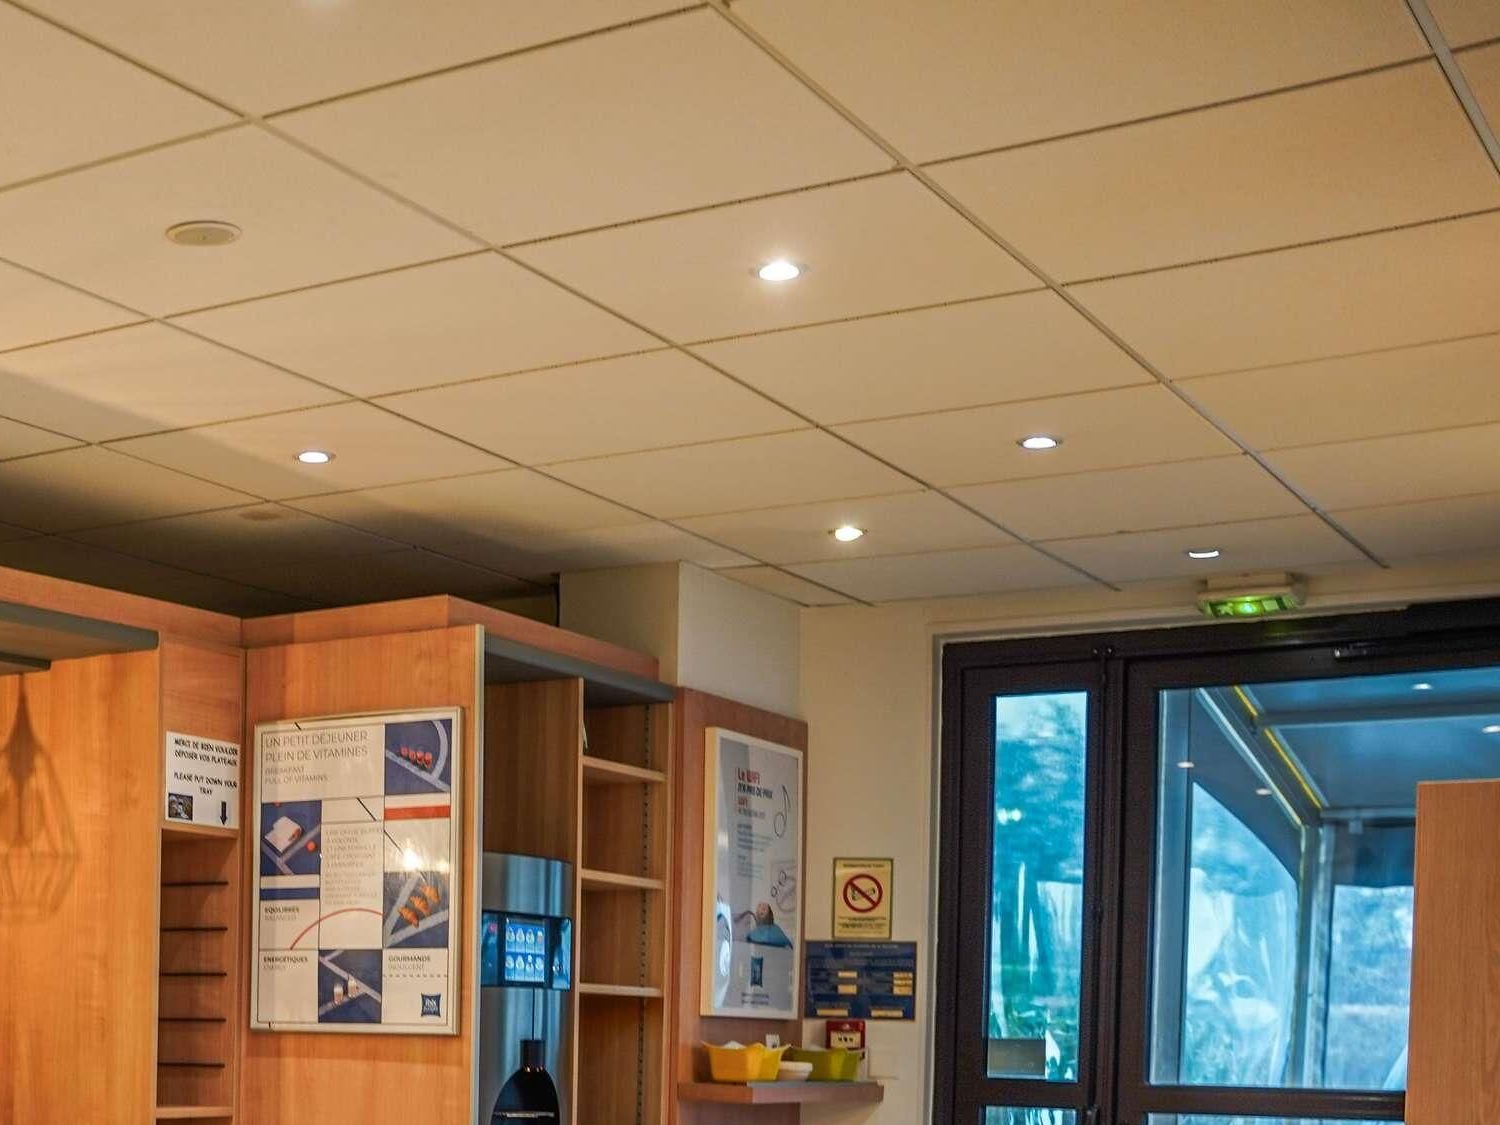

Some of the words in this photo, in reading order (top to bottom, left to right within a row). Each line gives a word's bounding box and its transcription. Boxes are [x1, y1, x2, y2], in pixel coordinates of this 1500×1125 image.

[283, 734, 310, 747] PETIT
[265, 750, 295, 762] PLEIN
[296, 750, 311, 761] DE
[311, 747, 368, 761] VITAMINES
[174, 772, 193, 784] PLEASE
[194, 774, 205, 784] PUT
[206, 776, 223, 787] DOWN
[199, 786, 212, 796] TRAY
